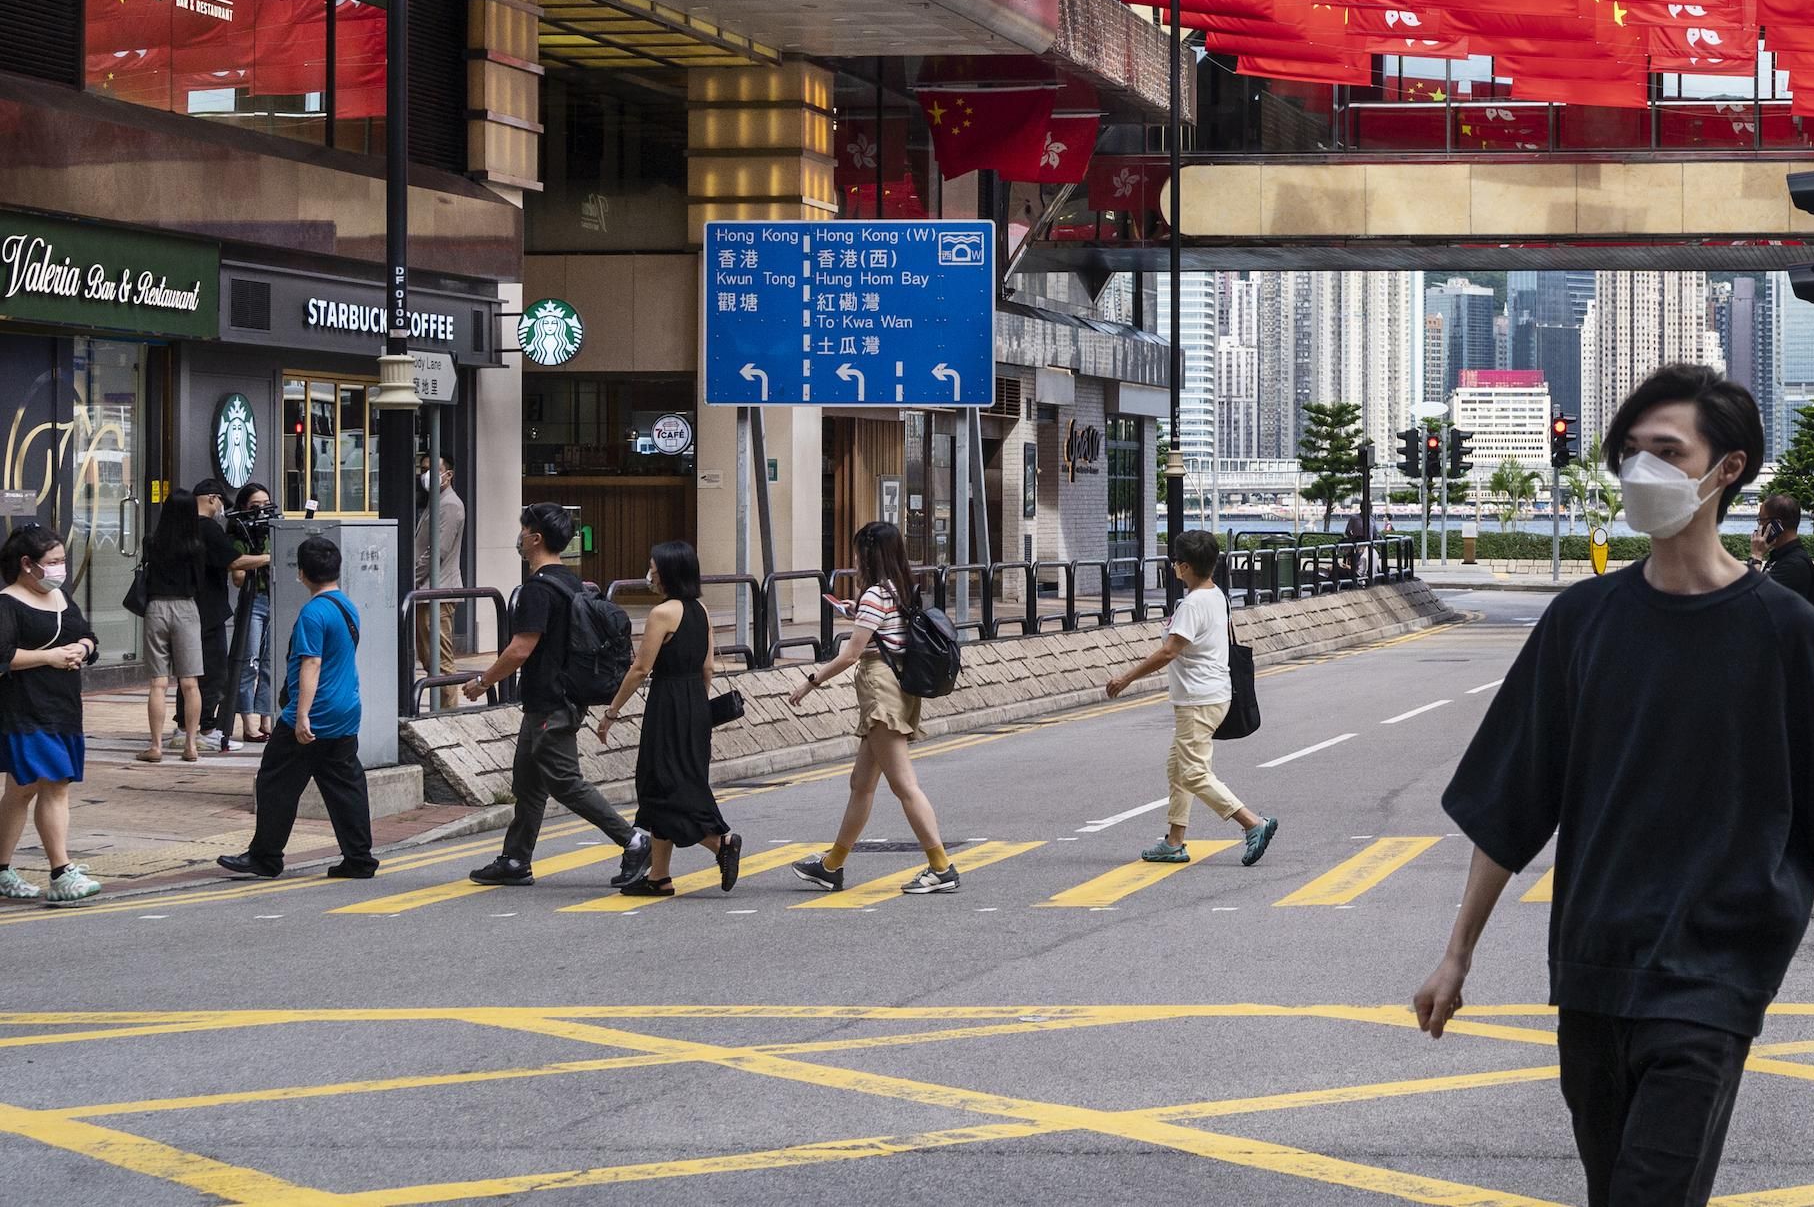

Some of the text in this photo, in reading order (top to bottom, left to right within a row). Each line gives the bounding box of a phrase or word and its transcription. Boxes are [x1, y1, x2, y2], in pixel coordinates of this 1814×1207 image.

[196, 0, 233, 22] RESTAURANT
[716, 228, 799, 244] Hong Kong
[816, 228, 936, 244] Hong Kong (W)
[718, 249, 759, 269] 香港
[816, 249, 897, 269] 香港(西)
[971, 251, 982, 260] W
[1, 234, 201, 311] Valeria Bar & Restaurant
[716, 271, 796, 288] Kwun Tong
[816, 271, 929, 288] Hung Hom Bay
[717, 292, 758, 312] 觀塘
[816, 293, 880, 312] 紅磡灣
[308, 297, 387, 334] STARBUCK
[816, 315, 913, 329] To Kwa Wan
[816, 336, 880, 355] 土瓜灣
[427, 357, 442, 371] Lane
